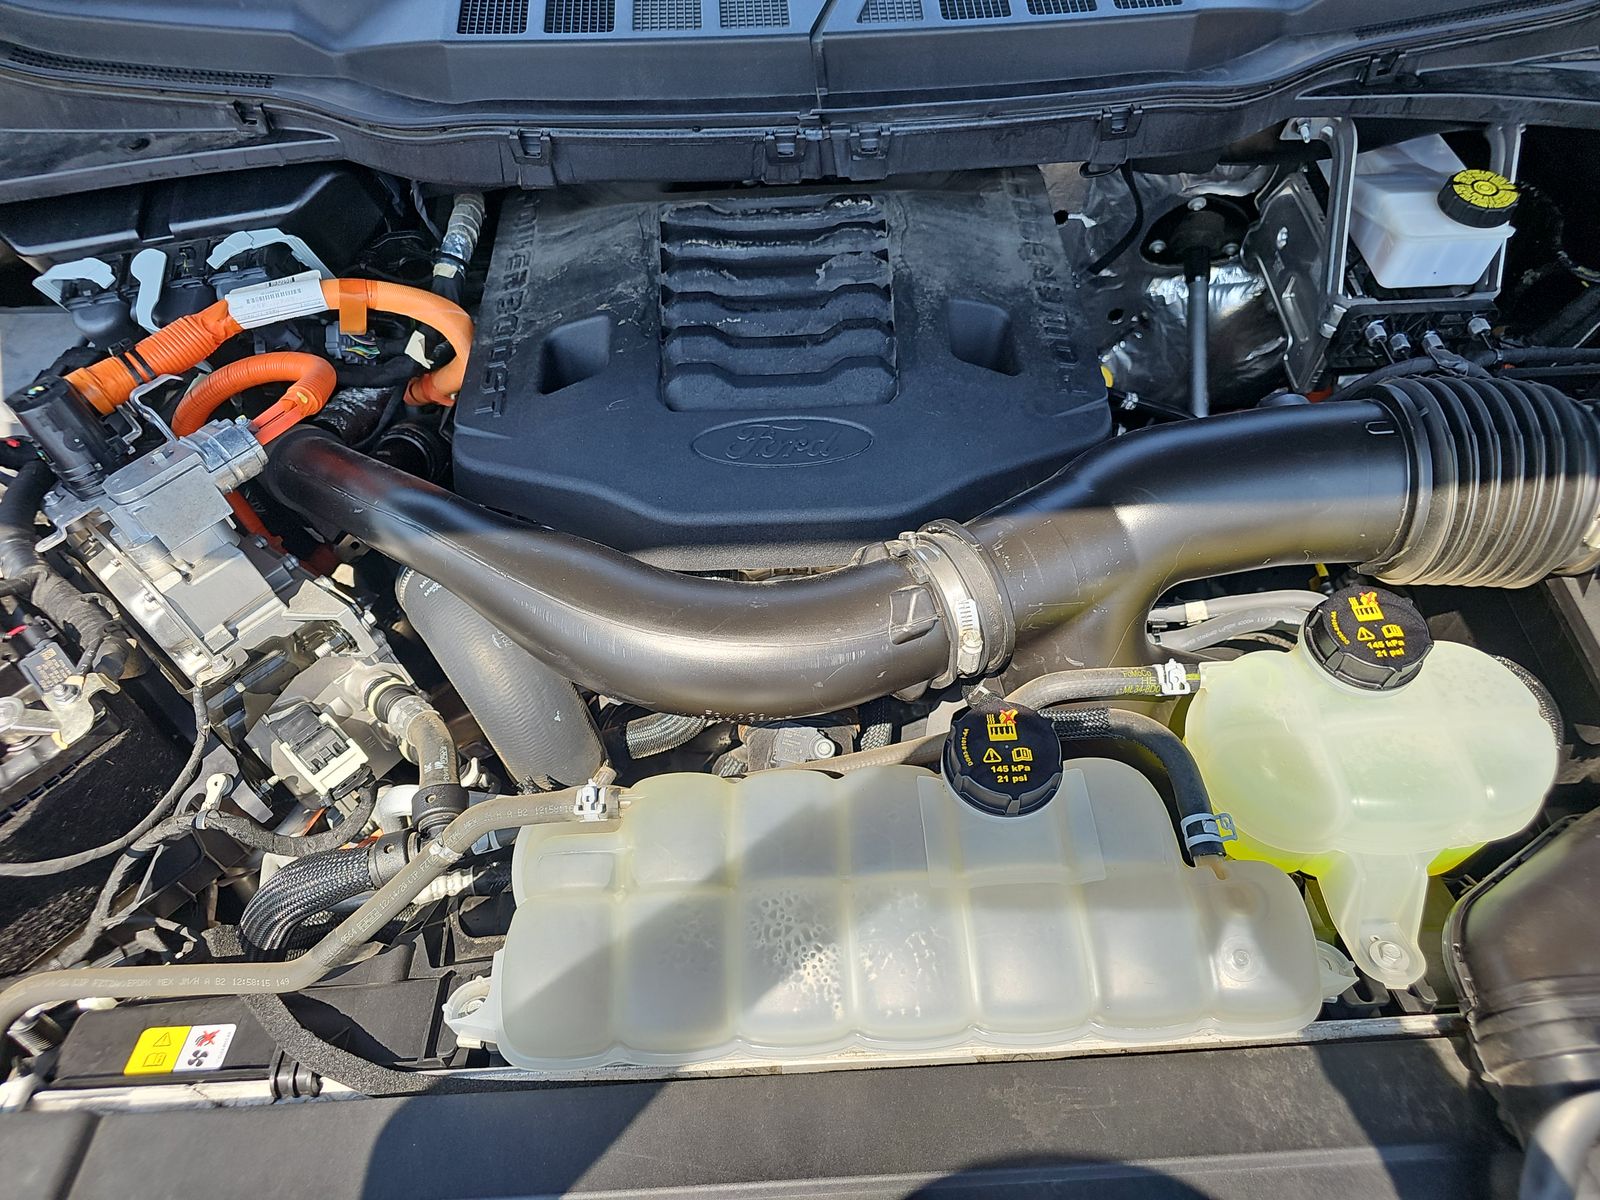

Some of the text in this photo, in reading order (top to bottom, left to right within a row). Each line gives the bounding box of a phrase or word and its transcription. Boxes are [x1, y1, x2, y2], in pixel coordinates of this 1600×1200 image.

[725, 424, 844, 460] Ford
[1366, 639, 1405, 650] 145 kPa
[1375, 648, 1405, 658] 21 psi
[1141, 677, 1157, 685] HE
[990, 764, 1031, 773] 145 kPa
[996, 774, 1028, 784] 21 psi
[232, 977, 271, 987] 12:58:15
